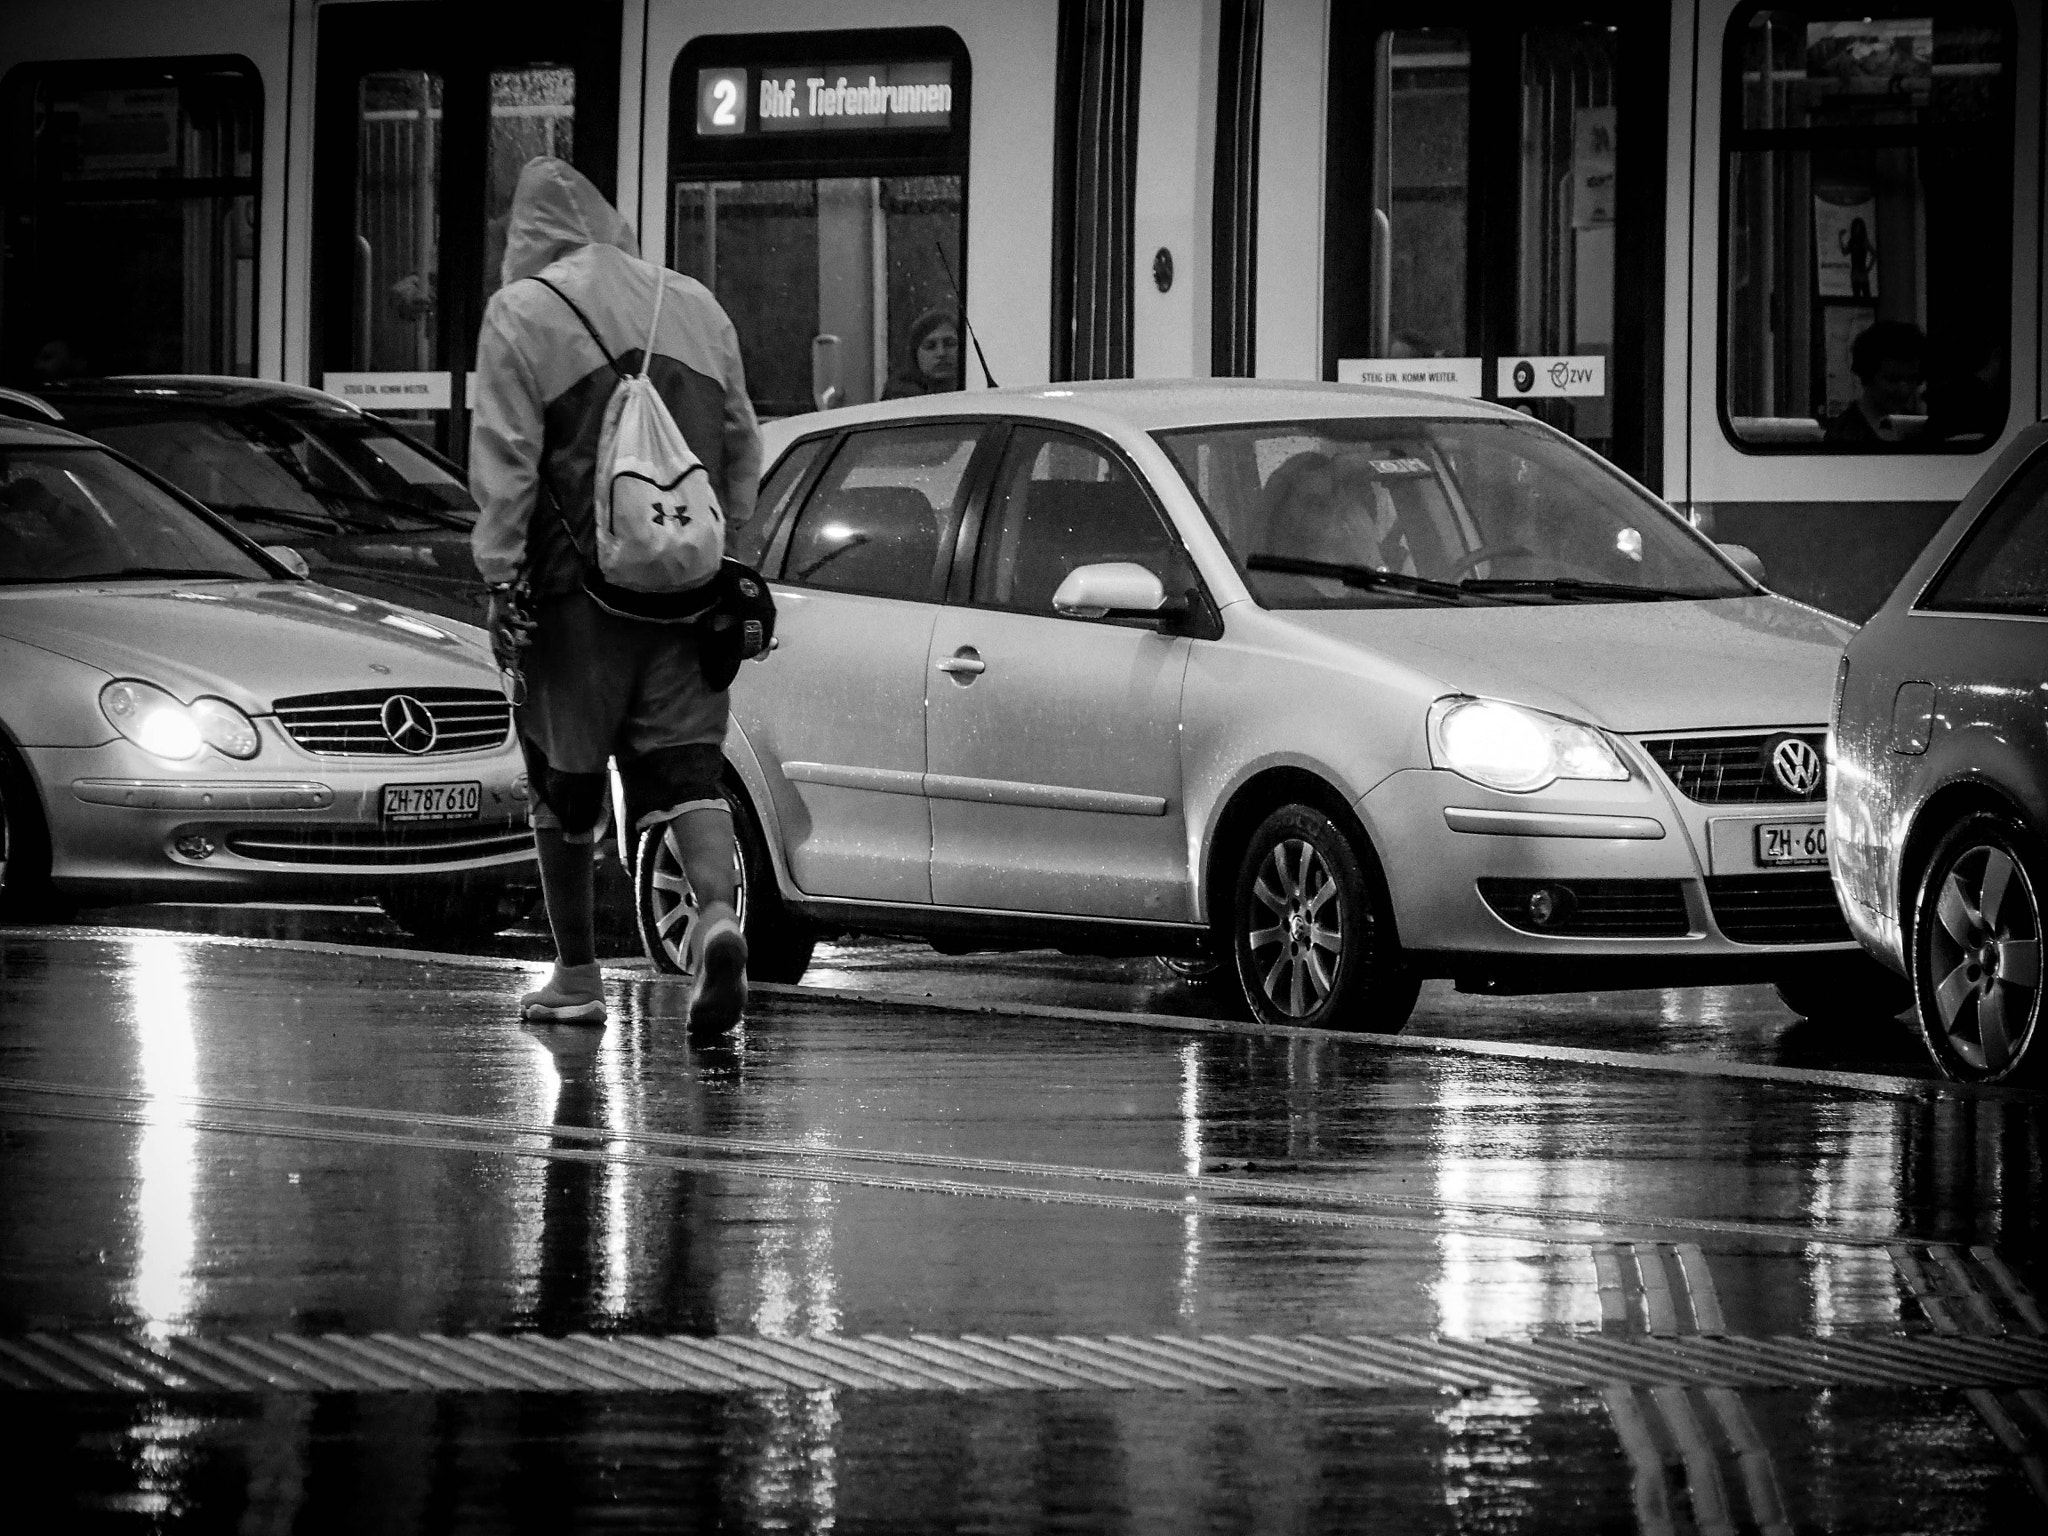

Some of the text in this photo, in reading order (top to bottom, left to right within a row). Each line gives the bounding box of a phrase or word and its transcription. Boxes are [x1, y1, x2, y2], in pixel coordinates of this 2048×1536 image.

[712, 78, 737, 125] 2
[760, 75, 952, 118] Bhf. Tiefenbrunnen
[1361, 371, 1383, 383] STEIG
[1402, 371, 1426, 383] KOMM
[1570, 369, 1593, 383] ZVV
